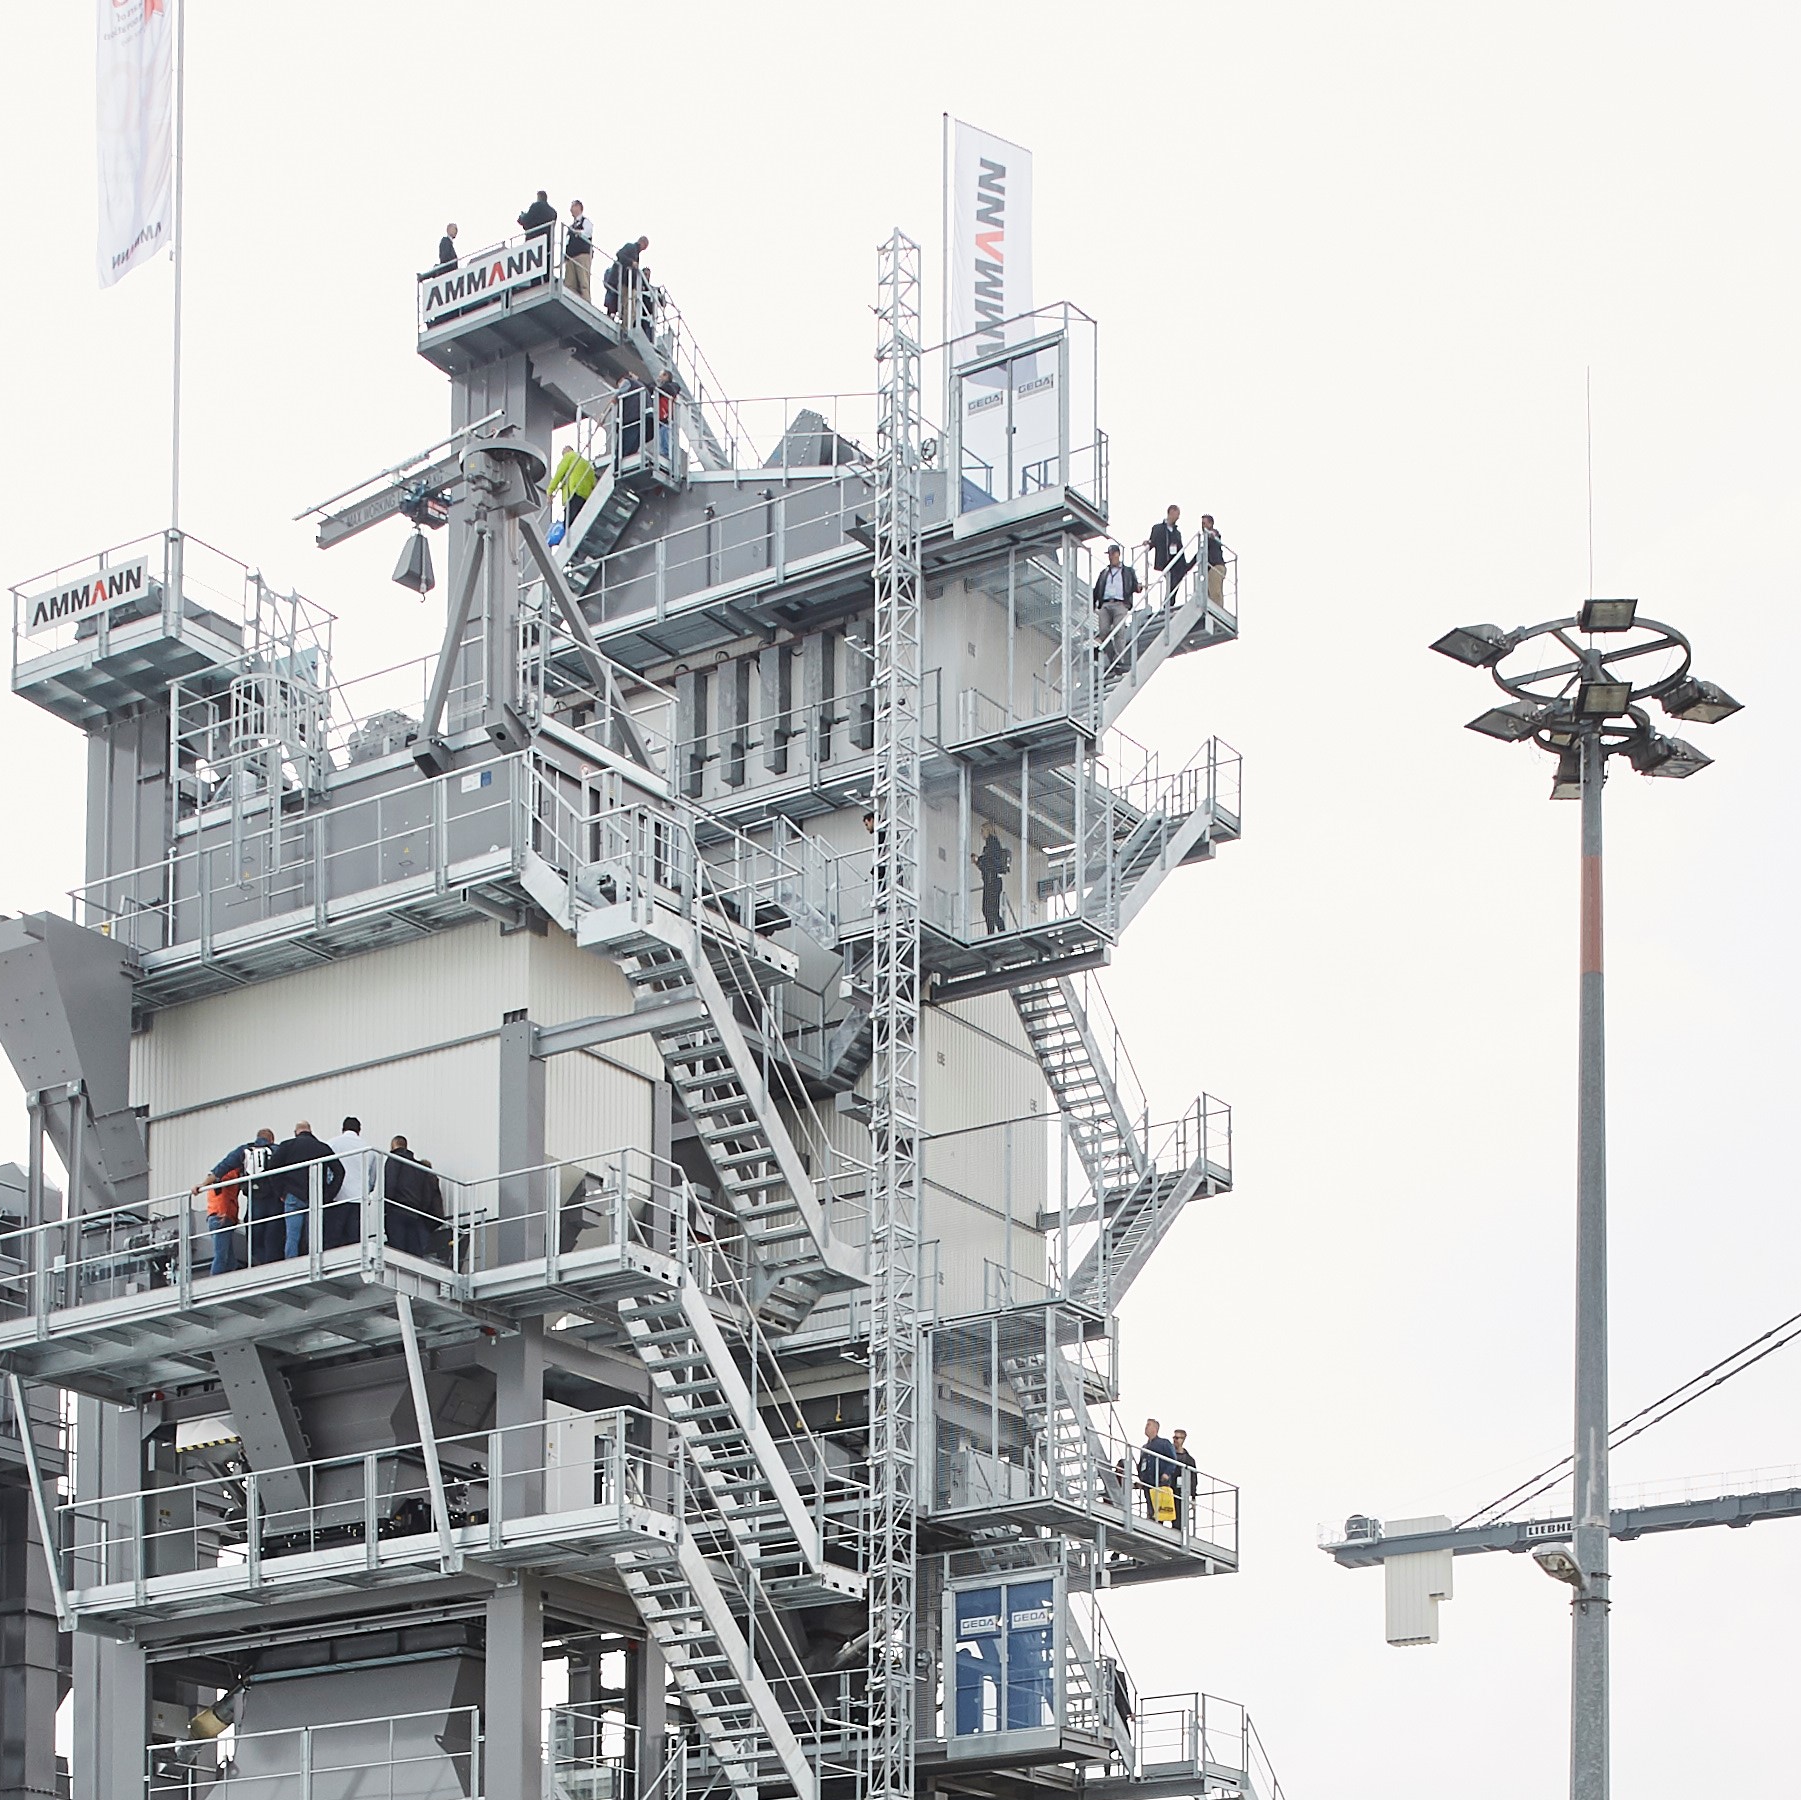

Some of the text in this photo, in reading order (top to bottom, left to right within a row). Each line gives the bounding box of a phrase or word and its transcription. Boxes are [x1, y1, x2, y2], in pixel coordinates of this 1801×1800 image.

[426, 245, 543, 311] AMMANN
[1019, 377, 1051, 394] GEDA
[968, 394, 999, 410] GEDA
[33, 566, 141, 626] AMMANN
[962, 1618, 994, 1629] GEDA
[1013, 1613, 1046, 1623] GEDA
